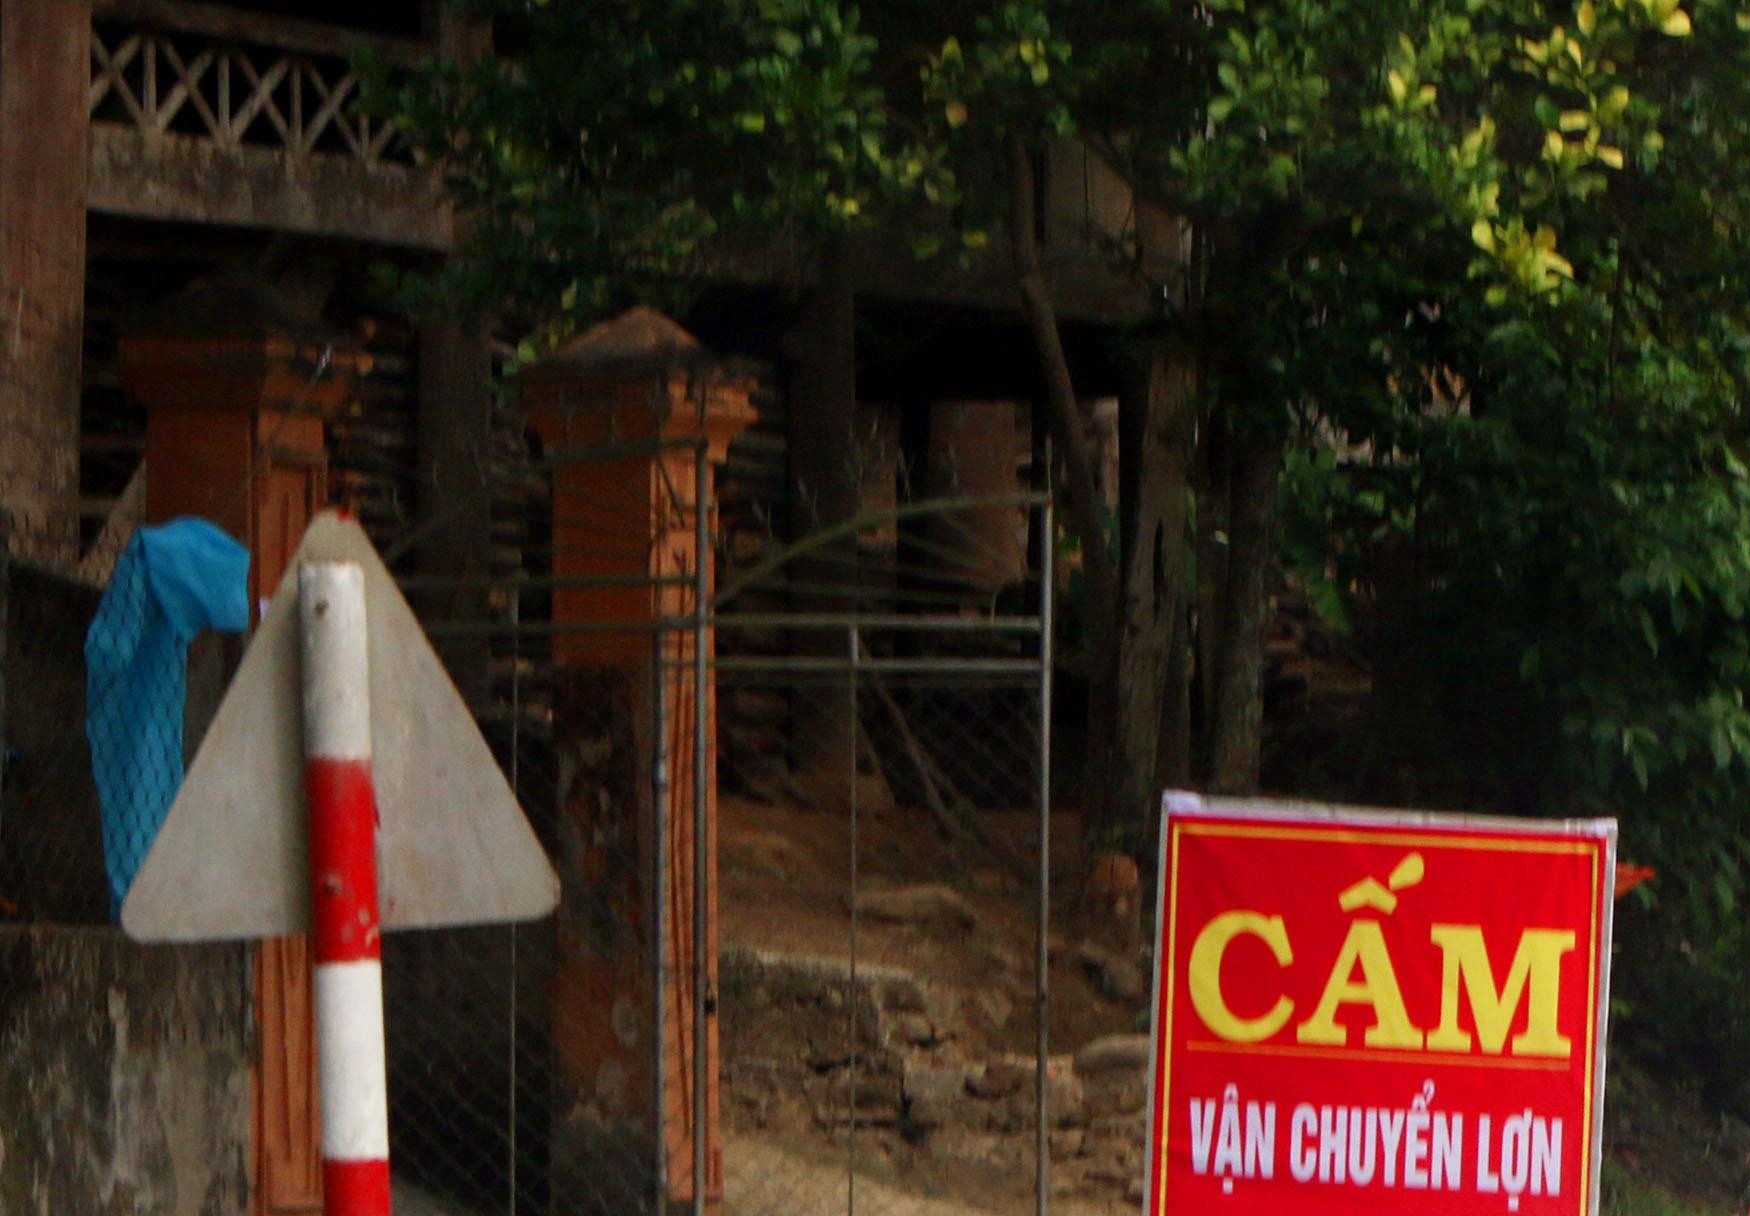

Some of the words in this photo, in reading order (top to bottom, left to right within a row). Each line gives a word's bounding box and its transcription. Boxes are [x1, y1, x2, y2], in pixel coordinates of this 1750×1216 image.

[1188, 853, 1576, 1058] CẤM
[1189, 1084, 1276, 1193] VẬN
[1288, 1079, 1463, 1190] CHUYỂN
[1476, 1109, 1563, 1212] LỢN
